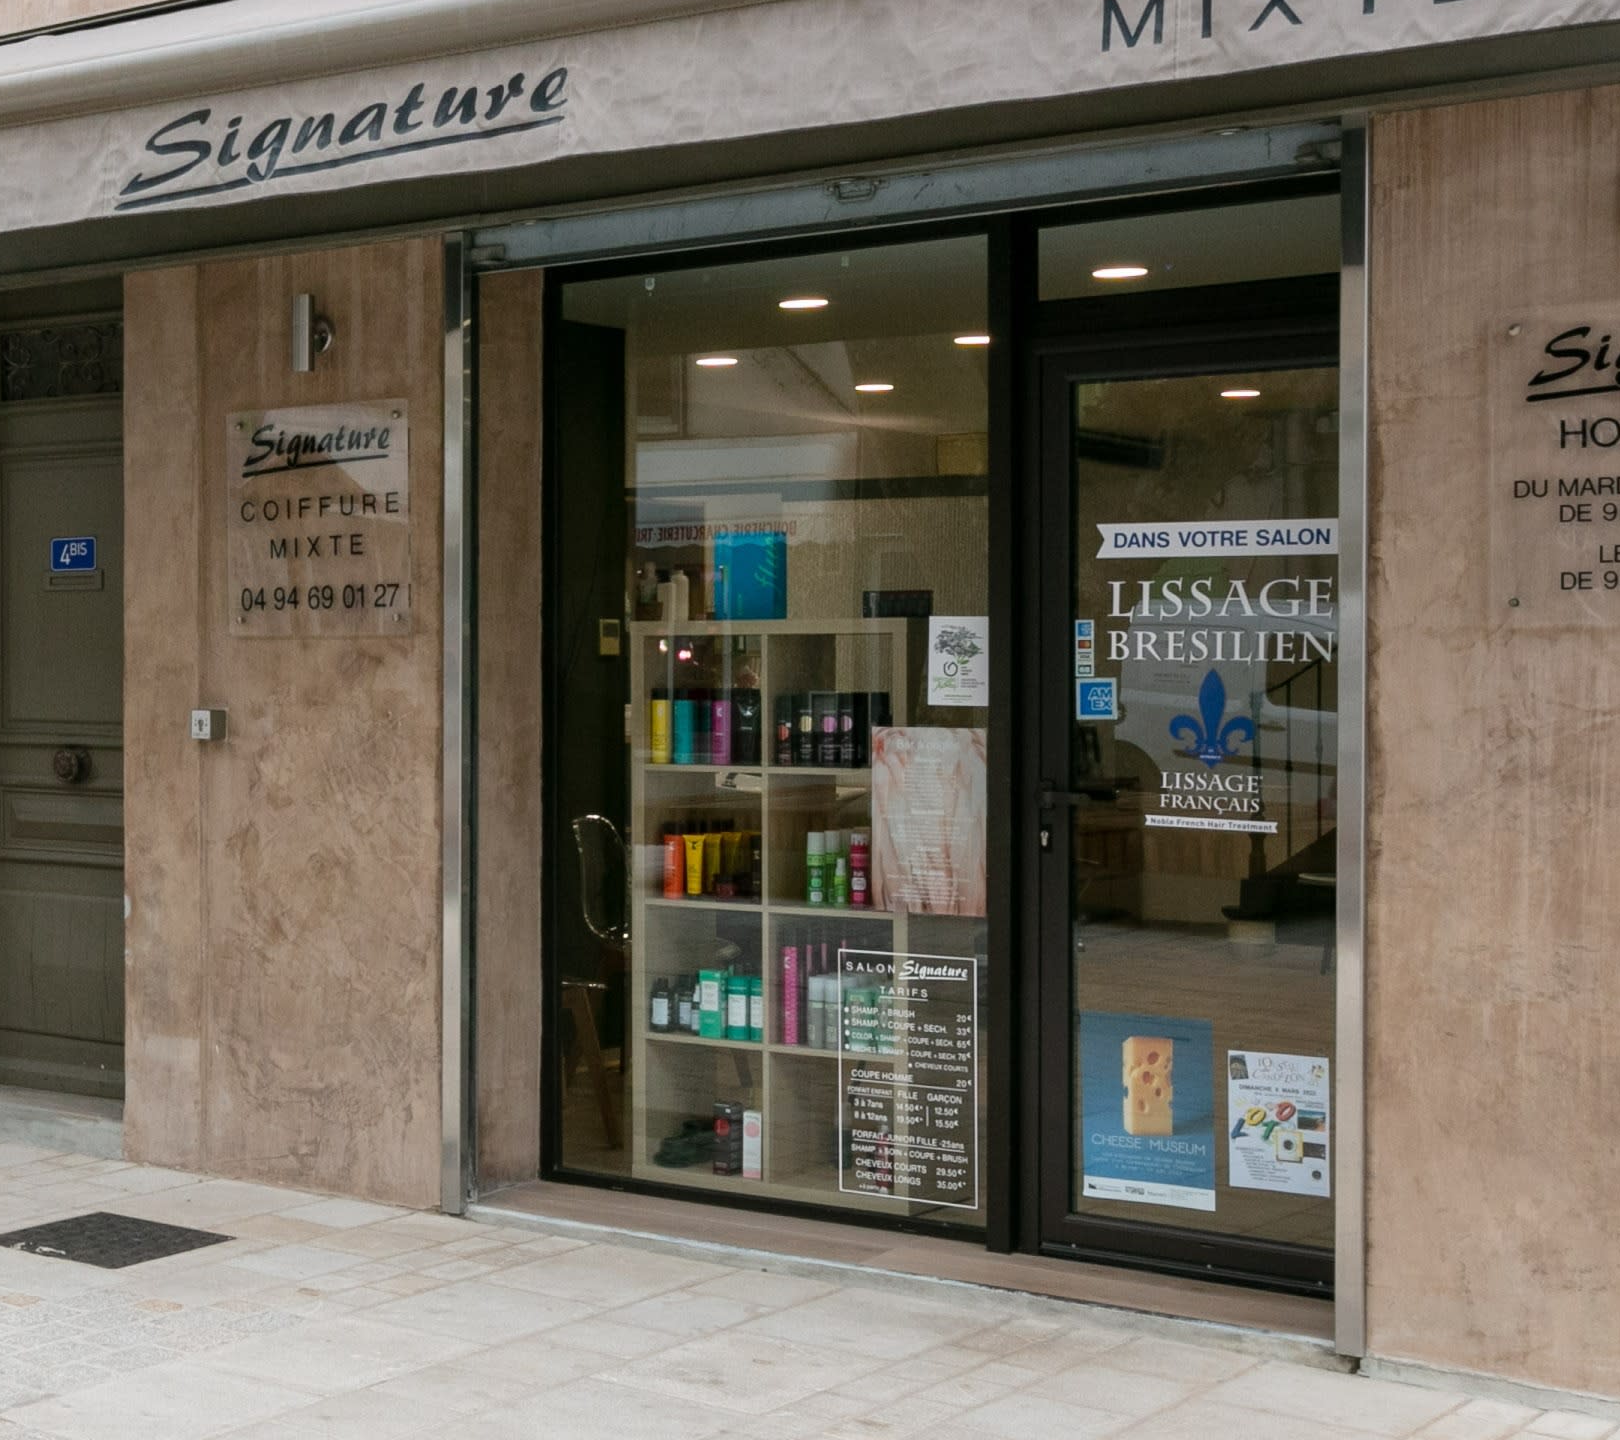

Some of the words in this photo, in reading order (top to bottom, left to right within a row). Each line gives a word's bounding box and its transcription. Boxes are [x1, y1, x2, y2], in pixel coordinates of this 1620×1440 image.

[119, 67, 568, 196] Signature
[243, 424, 390, 467] Signature
[1513, 479, 1548, 499] DU
[241, 491, 399, 522] COIFFURE
[1560, 503, 1592, 523] DE
[270, 534, 364, 559] MIXTE
[1114, 531, 1170, 548] DANS
[1179, 530, 1248, 547] VOTRE
[1256, 528, 1331, 546] SALON
[1560, 571, 1592, 590] DE
[241, 587, 266, 611] 04
[274, 586, 299, 610] 94
[308, 584, 334, 610] 69
[343, 584, 365, 609] 01
[374, 583, 400, 608] 27
[1107, 576, 1333, 623] LISSAGE
[1107, 627, 1335, 665] BRESILIEN
[1088, 687, 1112, 700] AM
[1091, 699, 1112, 710] EX
[1160, 771, 1259, 794] LISSAGE
[1160, 794, 1260, 814] FRANÇAIS
[1151, 817, 1174, 825] Noble
[1208, 820, 1224, 828] Hair
[1228, 822, 1272, 831] Treatment
[846, 961, 896, 973] SALON
[898, 960, 968, 978] Signature
[880, 986, 928, 998] TARIFS
[888, 1009, 915, 1018] BRUSH
[888, 1021, 915, 1031] COUPE
[923, 1024, 948, 1034] SECH.
[908, 1037, 929, 1045] COUPE
[910, 1050, 932, 1058] COUPE
[851, 1069, 880, 1079] COUPE
[882, 1071, 913, 1082] HOMME
[897, 1090, 918, 1100] FILLE
[927, 1093, 962, 1104] GARÇON
[1231, 1101, 1296, 1140] LOTO
[852, 1129, 884, 1141] FORFAIT
[886, 1134, 915, 1144] JUNIOR
[917, 1137, 937, 1146] FILLE
[1092, 1133, 1142, 1149] CHEESE
[1150, 1139, 1206, 1156] MUSEUM
[855, 1158, 892, 1169] CHEVEUX
[894, 1163, 927, 1174] COURTS
[909, 1151, 935, 1160] COUPE
[942, 1154, 968, 1164] BRUSH
[855, 1170, 892, 1182] CHEVEUX
[894, 1175, 921, 1186] LONGS
